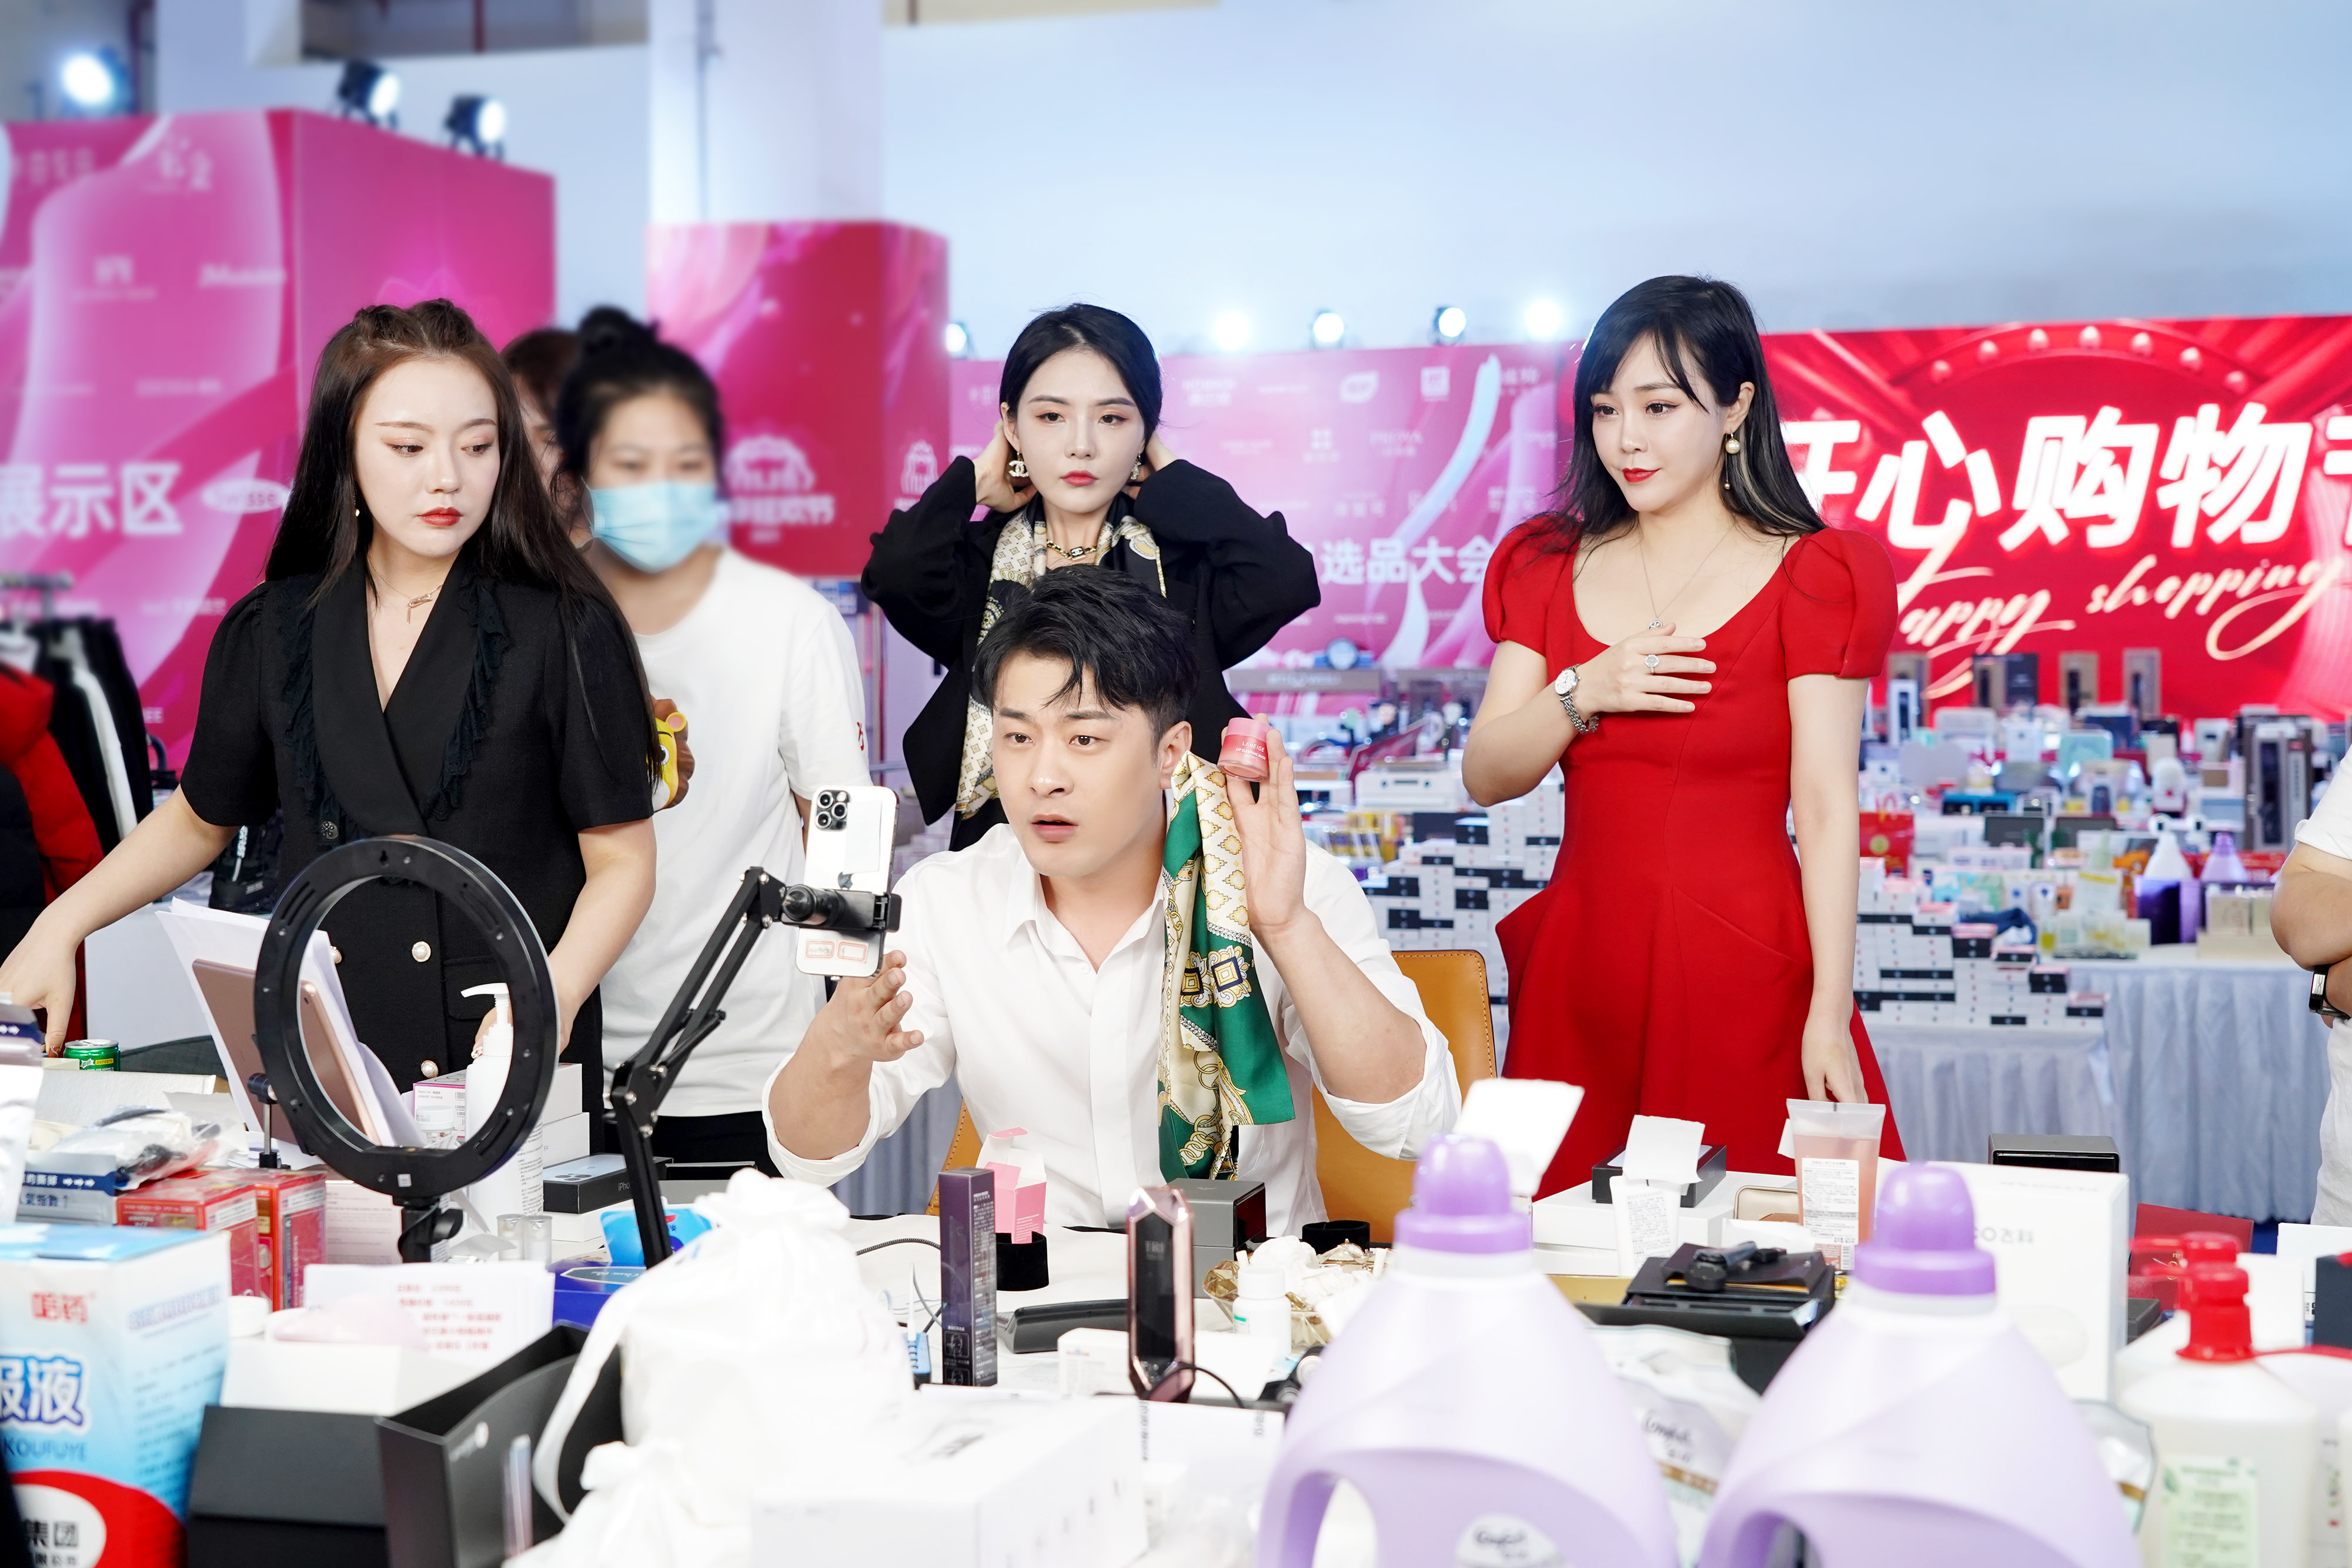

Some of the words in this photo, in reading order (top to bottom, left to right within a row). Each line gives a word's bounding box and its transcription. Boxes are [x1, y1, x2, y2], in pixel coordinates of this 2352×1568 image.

[0, 462, 183, 539] 展示区
[1779, 402, 2352, 550] 开心购物
[1304, 535, 1496, 585] 选品大会
[2085, 554, 2346, 662] shopping
[1242, 741, 1265, 753] LANEIGE
